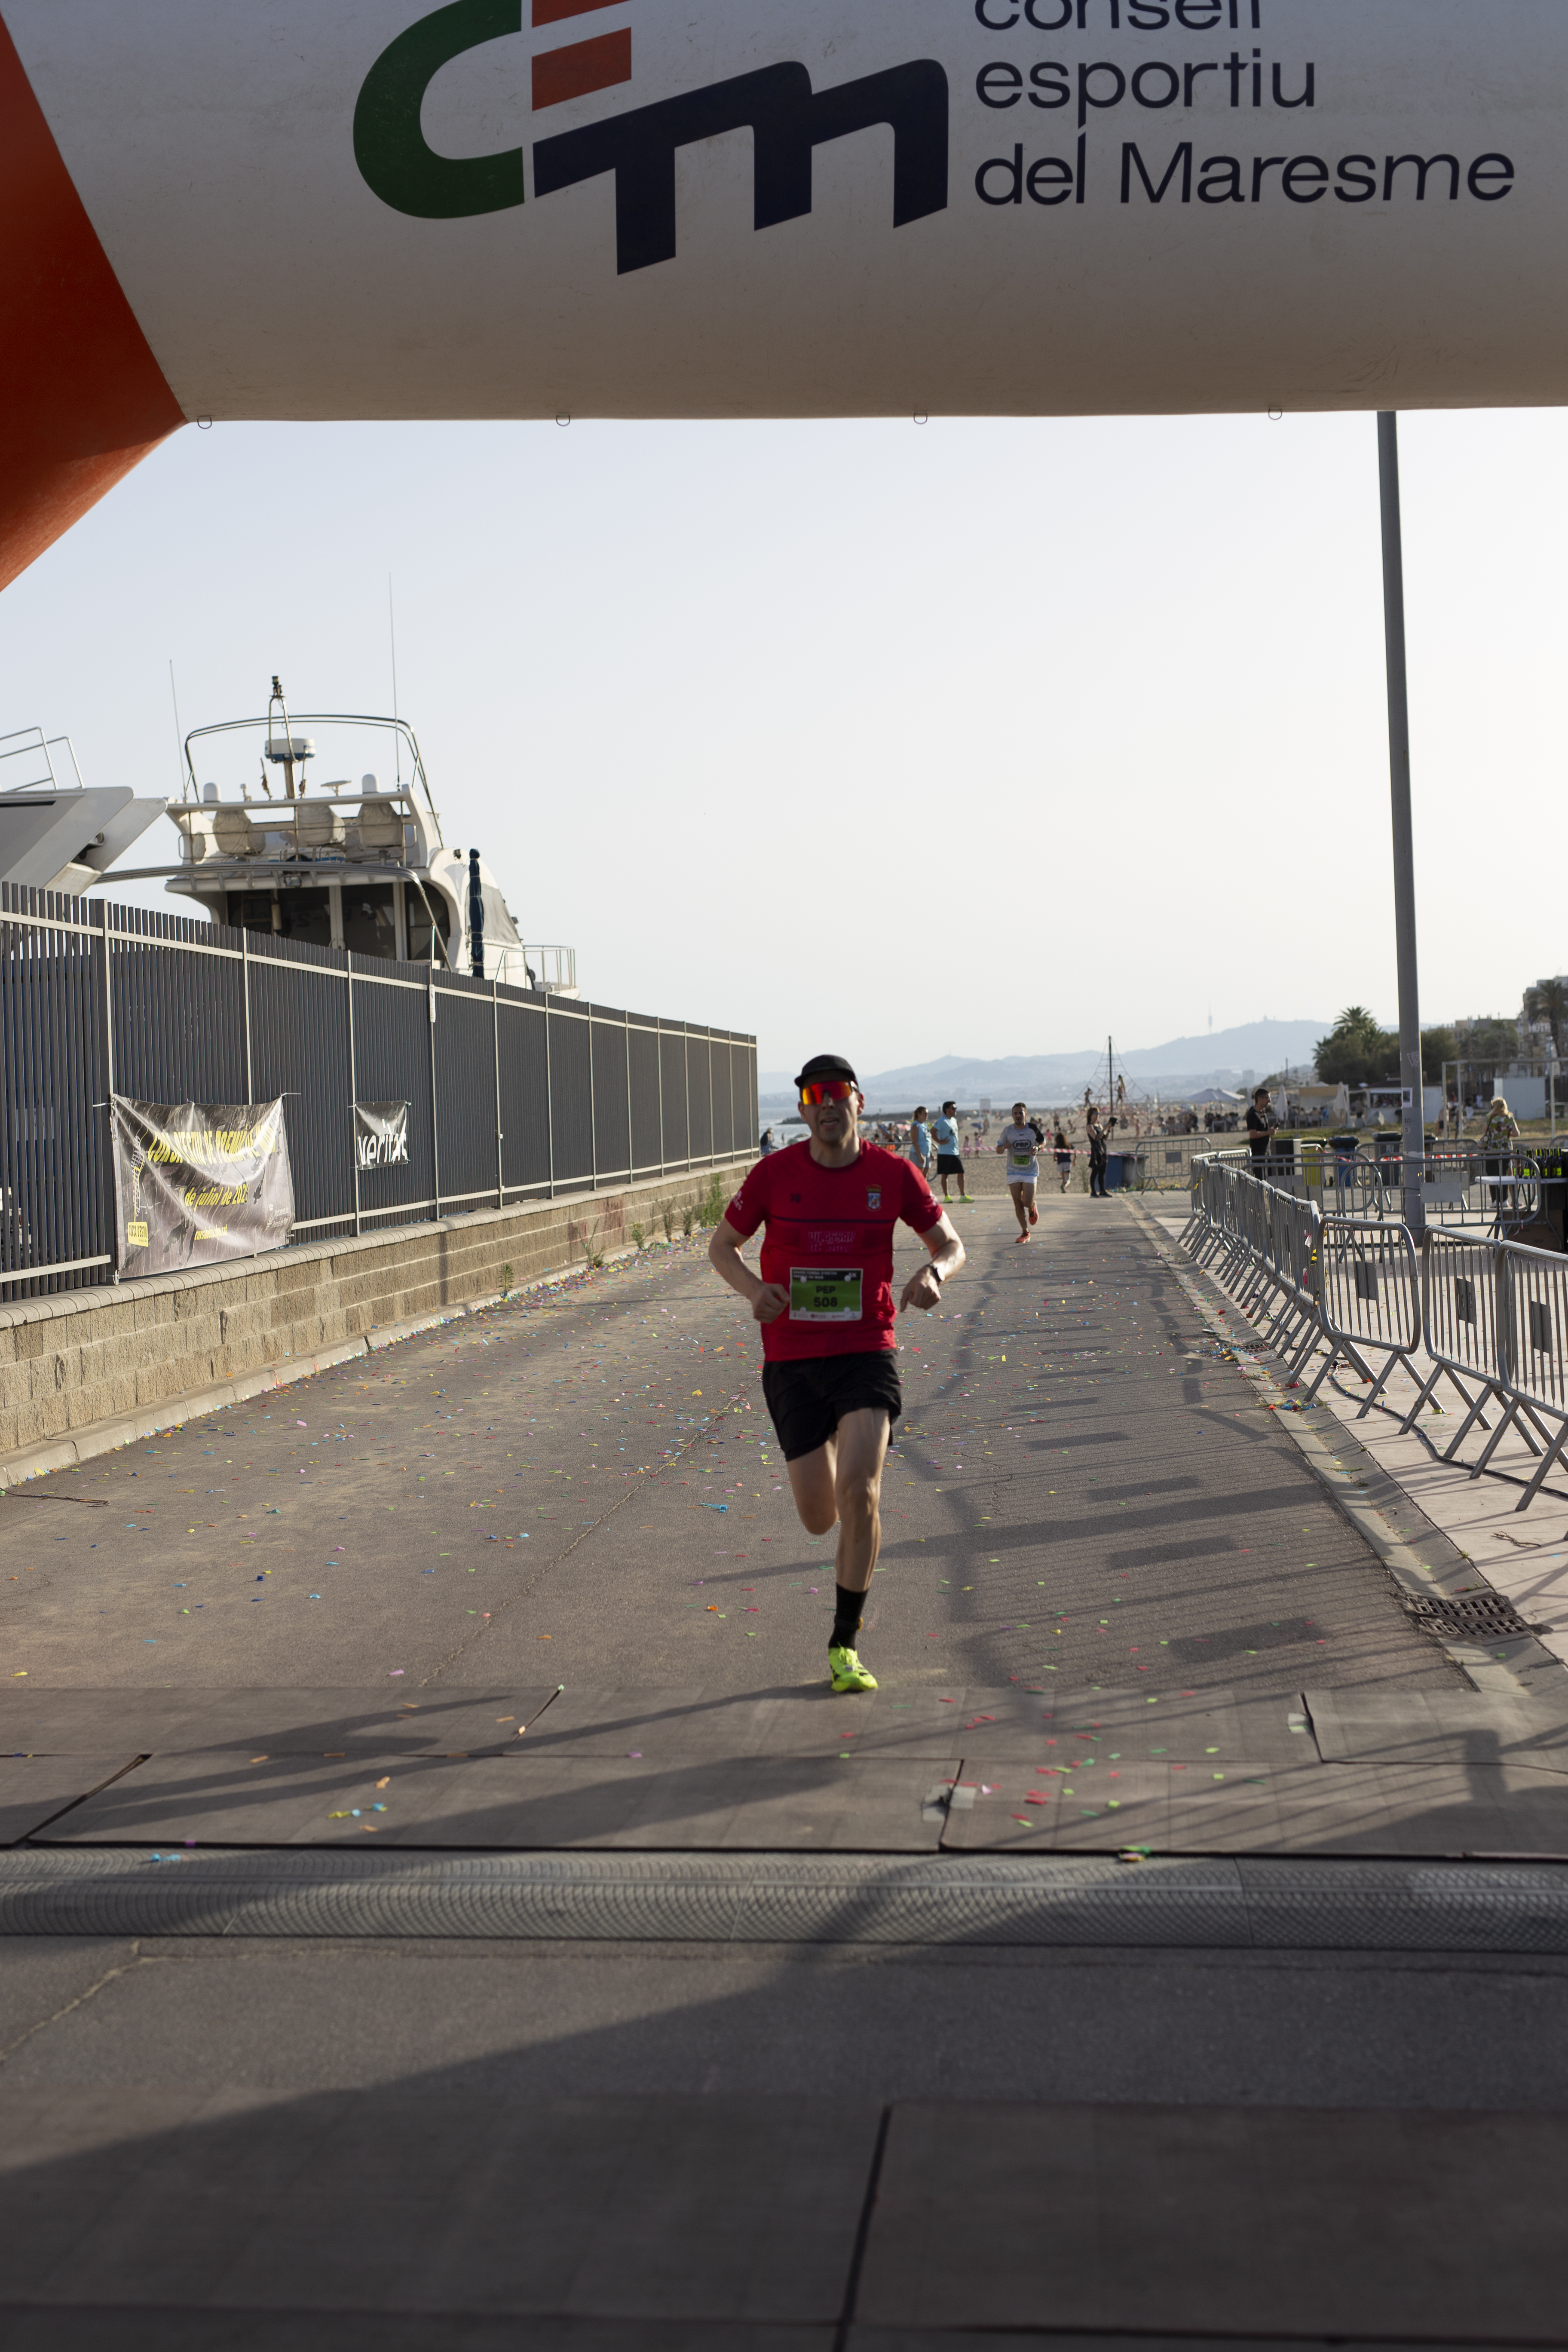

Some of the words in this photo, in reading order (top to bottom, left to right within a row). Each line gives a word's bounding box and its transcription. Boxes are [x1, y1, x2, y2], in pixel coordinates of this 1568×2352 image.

[975, 48, 1315, 129] esportiu
[974, 132, 1087, 206] del
[1120, 141, 1515, 204] Maresme
[203, 1130, 217, 1165] DE
[185, 1187, 196, 1207] de
[194, 1186, 224, 1212] juliol
[220, 1186, 233, 1205] de
[129, 1225, 137, 1237] CURSA
[814, 1297, 838, 1307] 508
[815, 1286, 836, 1294] PEP
